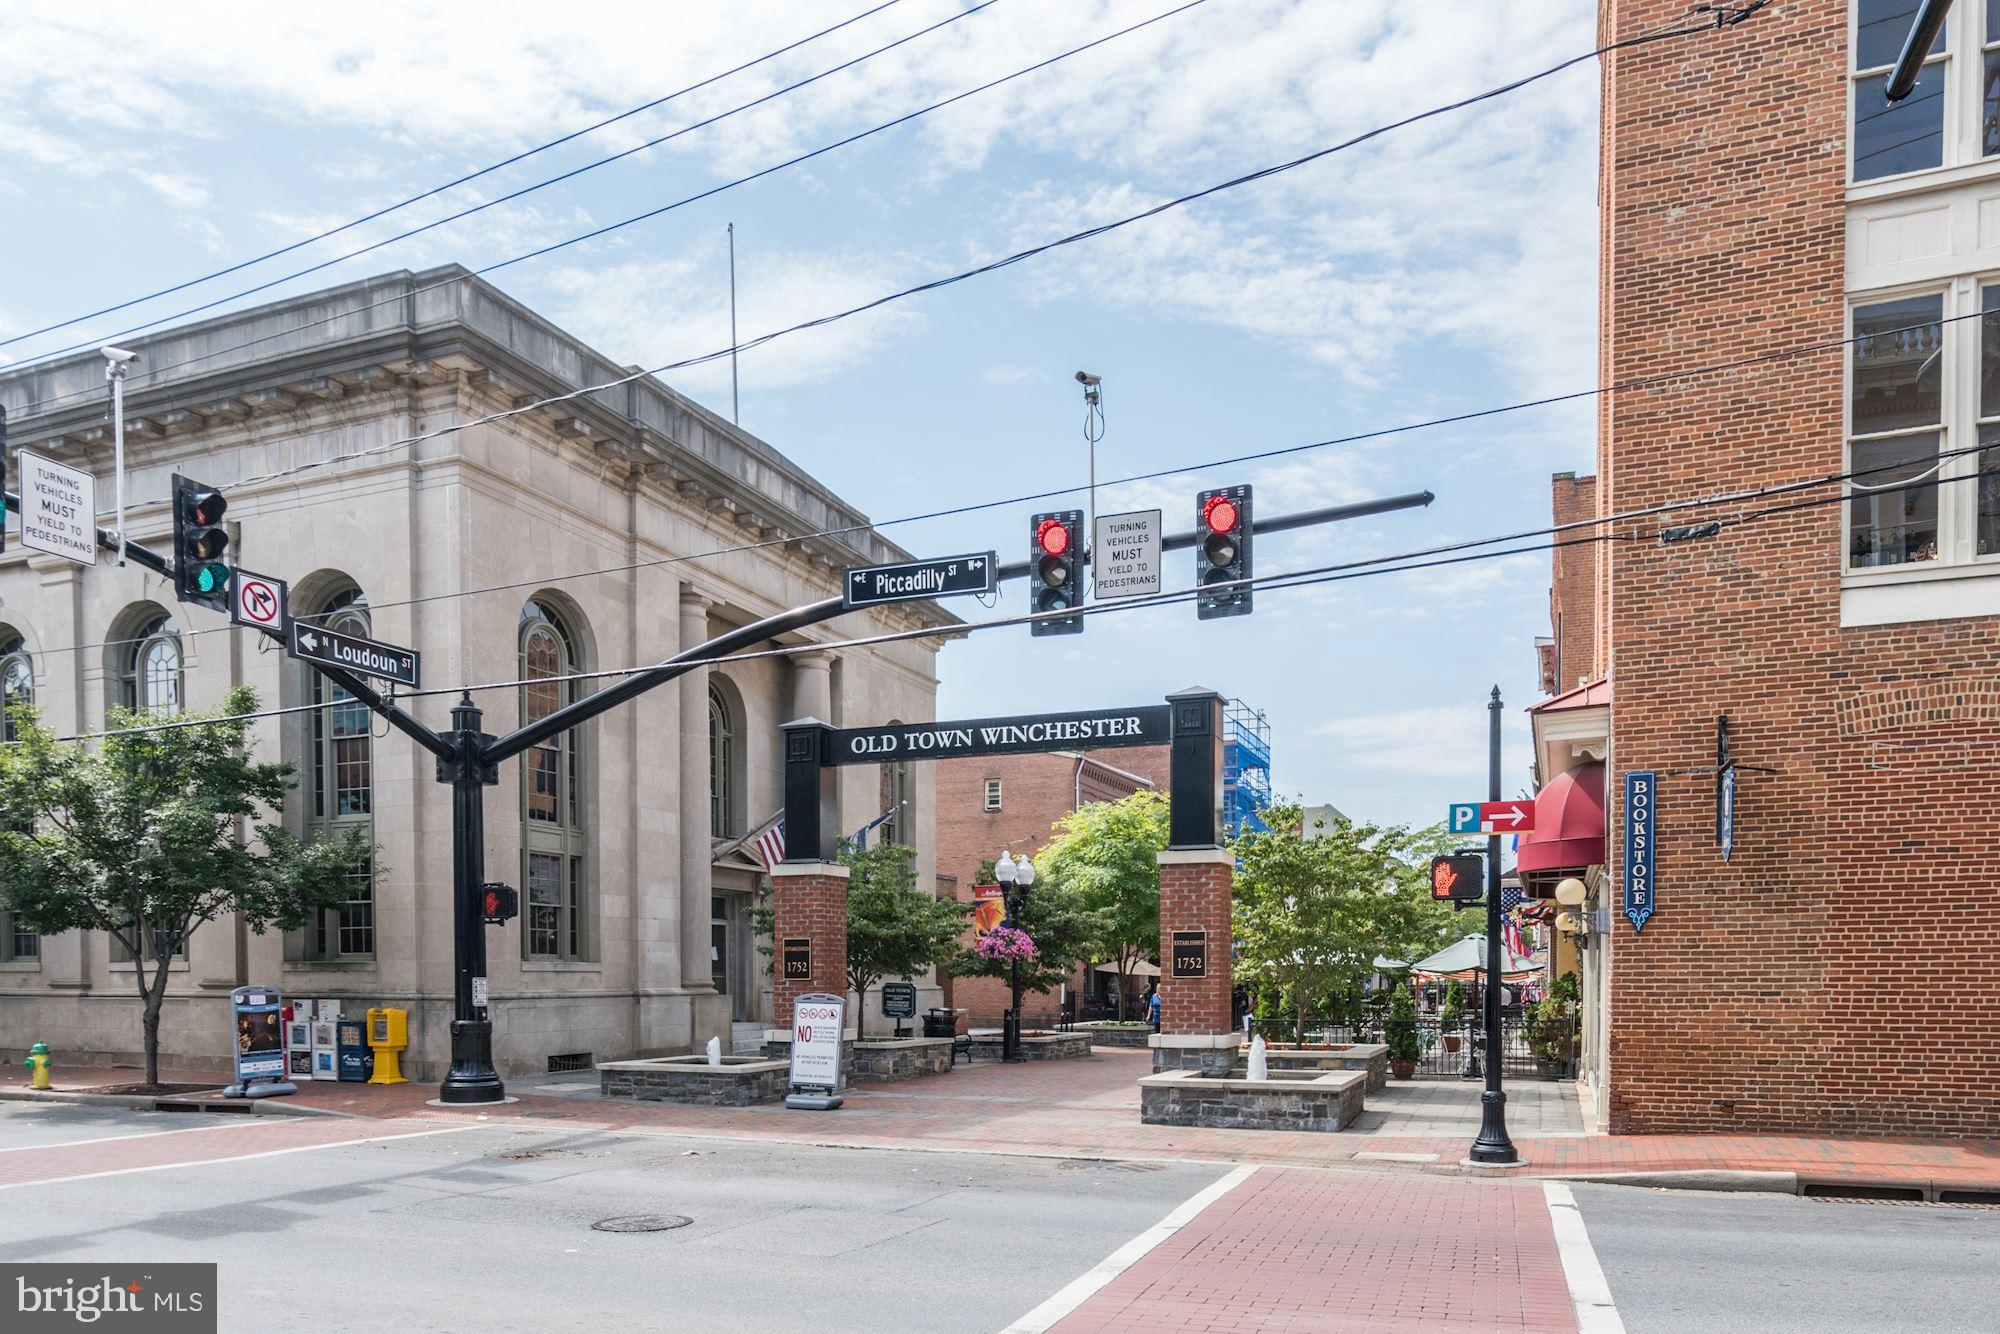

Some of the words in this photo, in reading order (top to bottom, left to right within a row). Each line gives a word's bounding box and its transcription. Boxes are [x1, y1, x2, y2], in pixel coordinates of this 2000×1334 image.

[37, 467, 80, 490] TURNING
[35, 481, 83, 506] VEHICLES
[42, 499, 76, 519] MUST
[37, 514, 65, 531] YIELD
[70, 525, 82, 536] TO
[1109, 521, 1147, 533] TURNING
[26, 526, 92, 554] PEDESTRIANS
[1107, 534, 1150, 547] VEHICLES
[1112, 547, 1143, 561] MUST
[861, 573, 867, 583] E
[876, 568, 945, 595] Piccadilly
[948, 564, 958, 576] ST
[968, 560, 975, 571] W
[1108, 564, 1133, 575] YIELD
[1137, 562, 1148, 572] TO
[1098, 575, 1157, 589] PEDESTRIANS
[322, 636, 329, 647] N
[333, 639, 397, 674] Loudoun
[401, 657, 412, 669] ST
[850, 734, 898, 754] OLD
[904, 728, 974, 751] TOWN
[980, 716, 1143, 745] WINCHESTER
[1455, 806, 1474, 831] P
[1632, 780, 1648, 905] BOOKSTORE
[787, 961, 808, 973] 1752
[1177, 956, 1202, 969] 1752
[797, 1025, 812, 1043] NO
